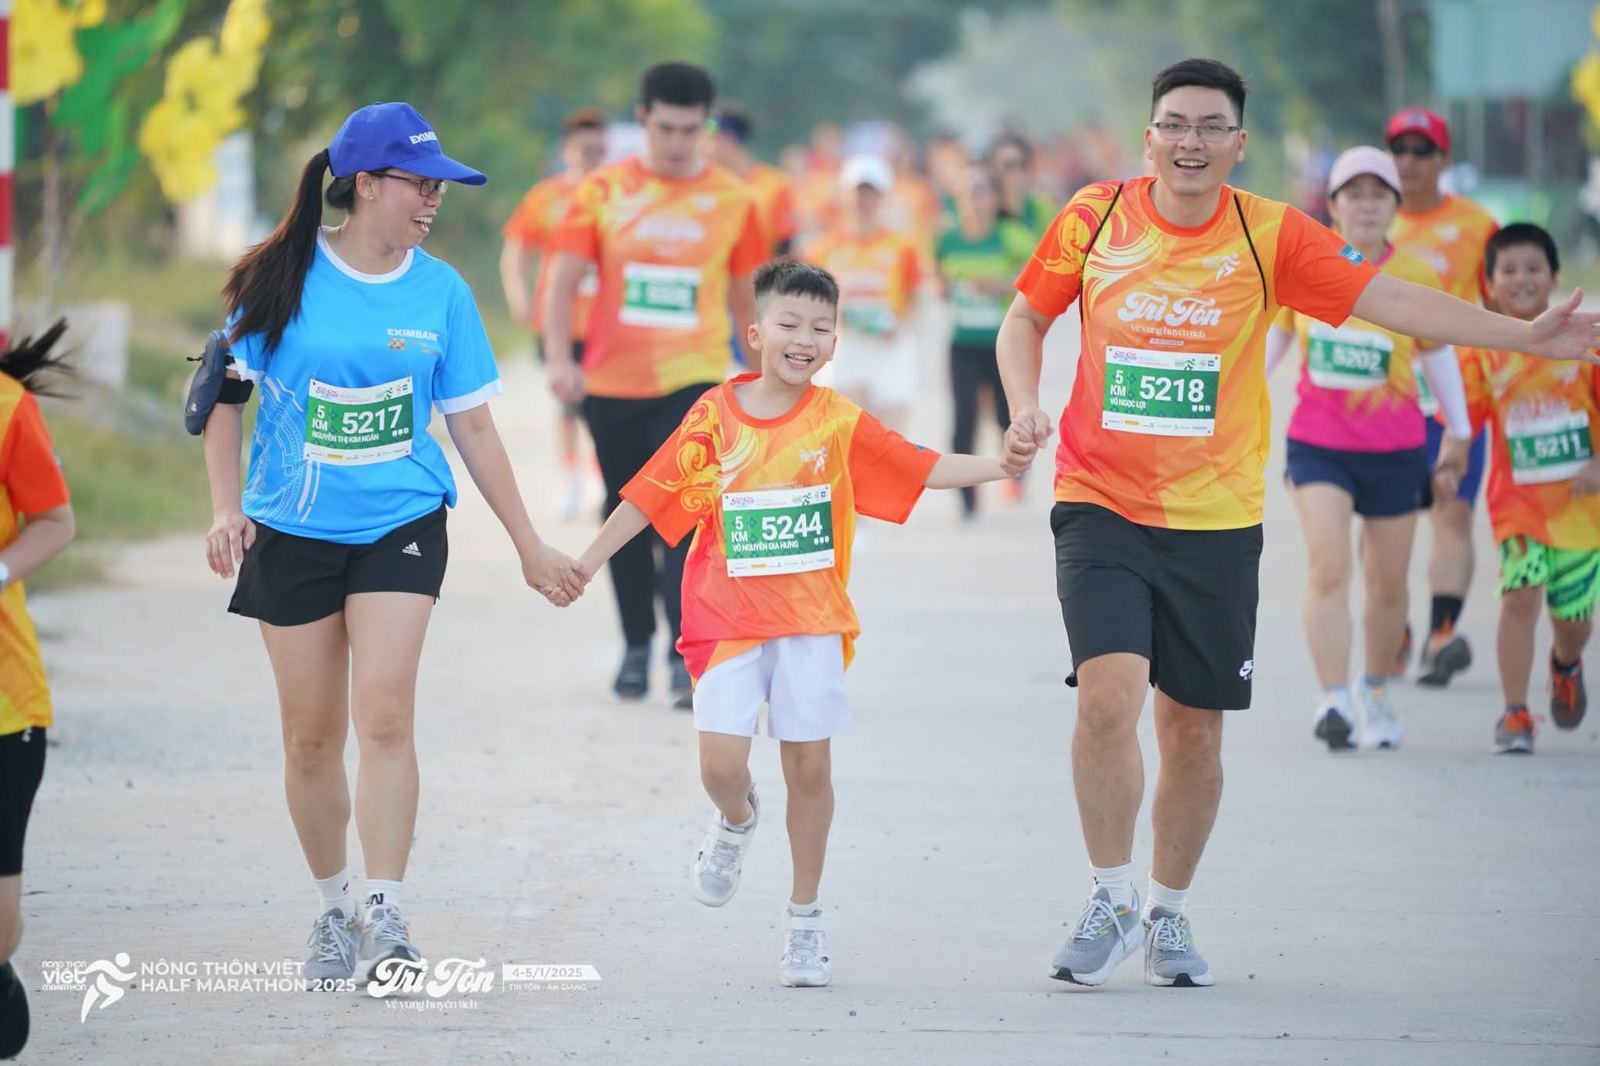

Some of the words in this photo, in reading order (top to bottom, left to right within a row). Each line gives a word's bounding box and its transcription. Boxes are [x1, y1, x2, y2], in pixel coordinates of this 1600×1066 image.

[1117, 291, 1168, 322] Tri
[1115, 370, 1123, 384] 5
[1110, 384, 1126, 397] KM
[1139, 375, 1205, 403] 5218
[317, 405, 325, 419] 5
[312, 418, 328, 431] KM
[341, 404, 403, 435] 5217
[735, 516, 743, 530] 5
[761, 511, 822, 541] 5244
[731, 531, 749, 543] KM
[768, 541, 780, 550] GIA
